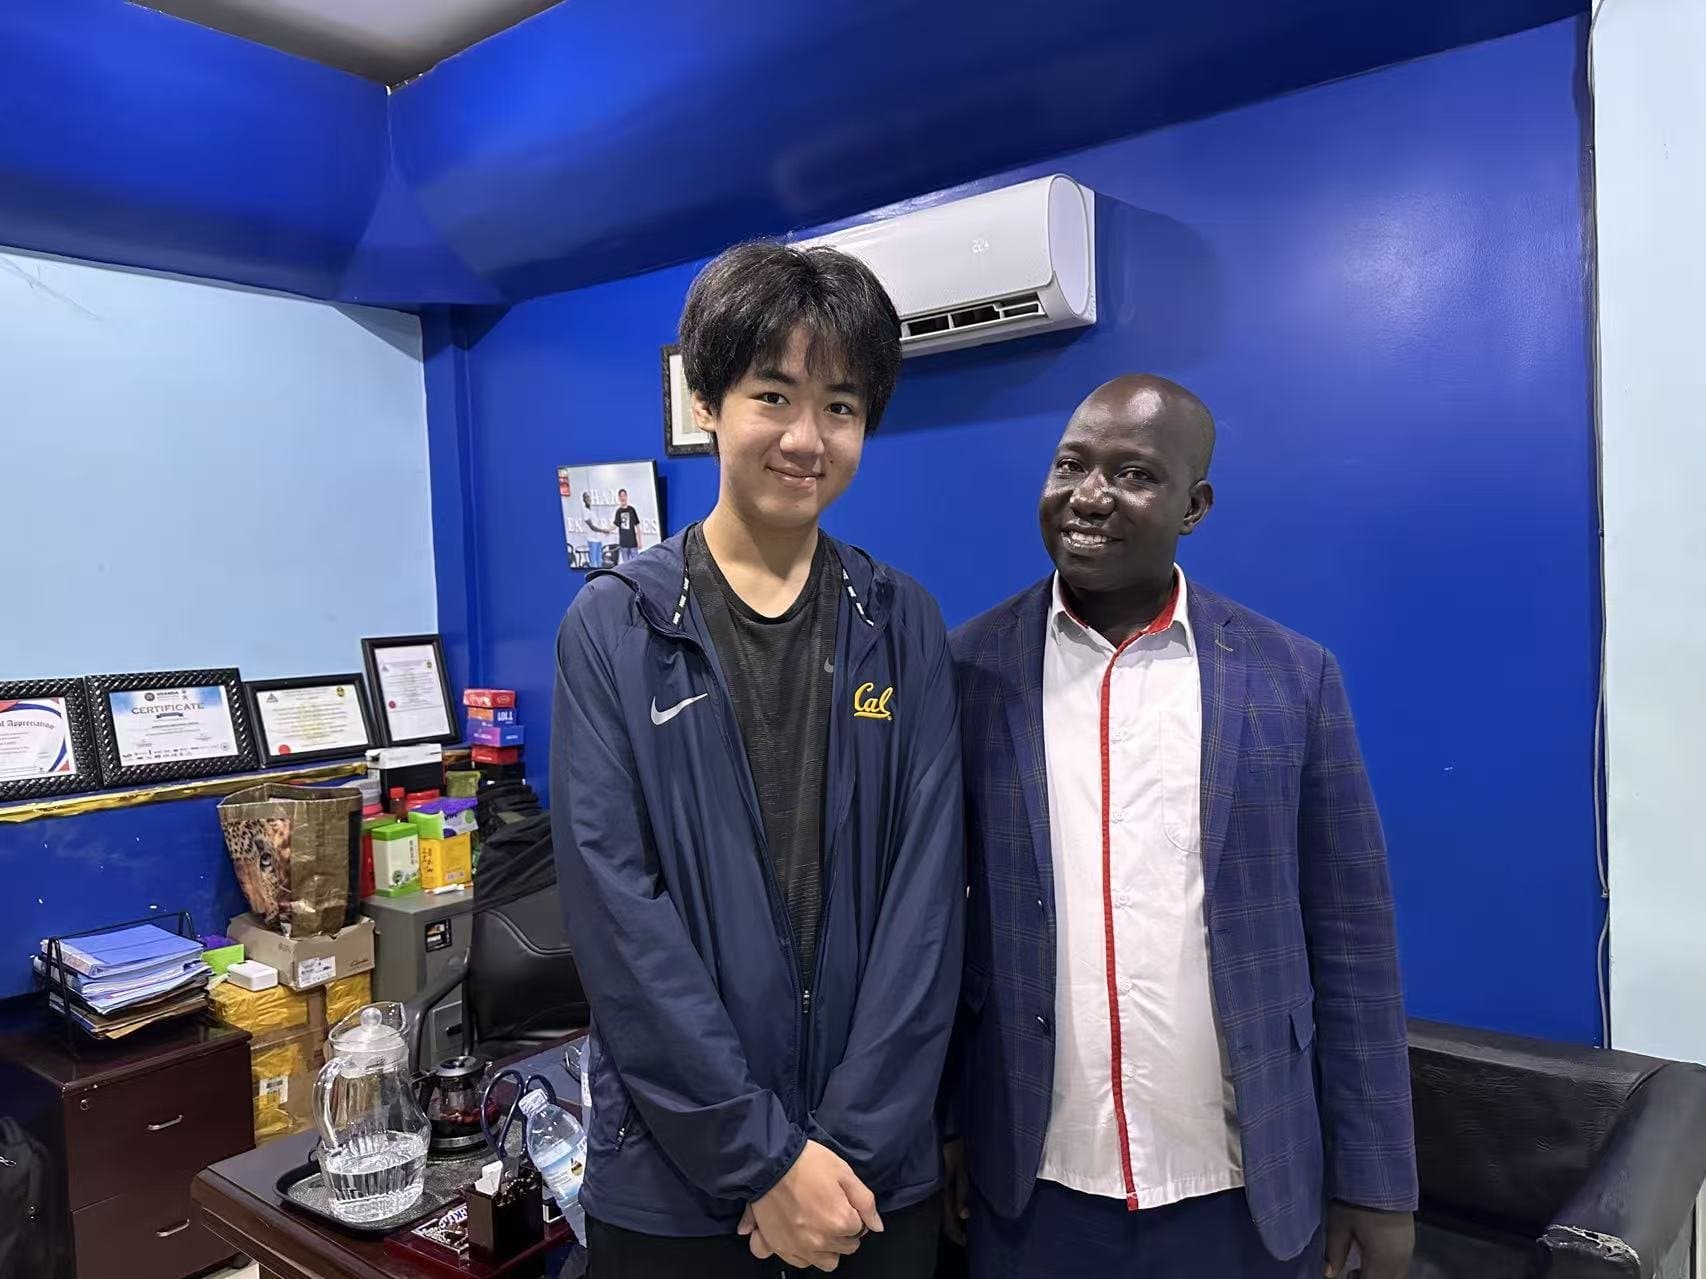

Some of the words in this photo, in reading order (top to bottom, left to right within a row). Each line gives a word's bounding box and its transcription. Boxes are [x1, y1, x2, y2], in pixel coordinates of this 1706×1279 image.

[854, 682, 894, 718] Cal
[131, 702, 205, 715] CERTIFICATE
[6, 719, 55, 730] Appreciation
